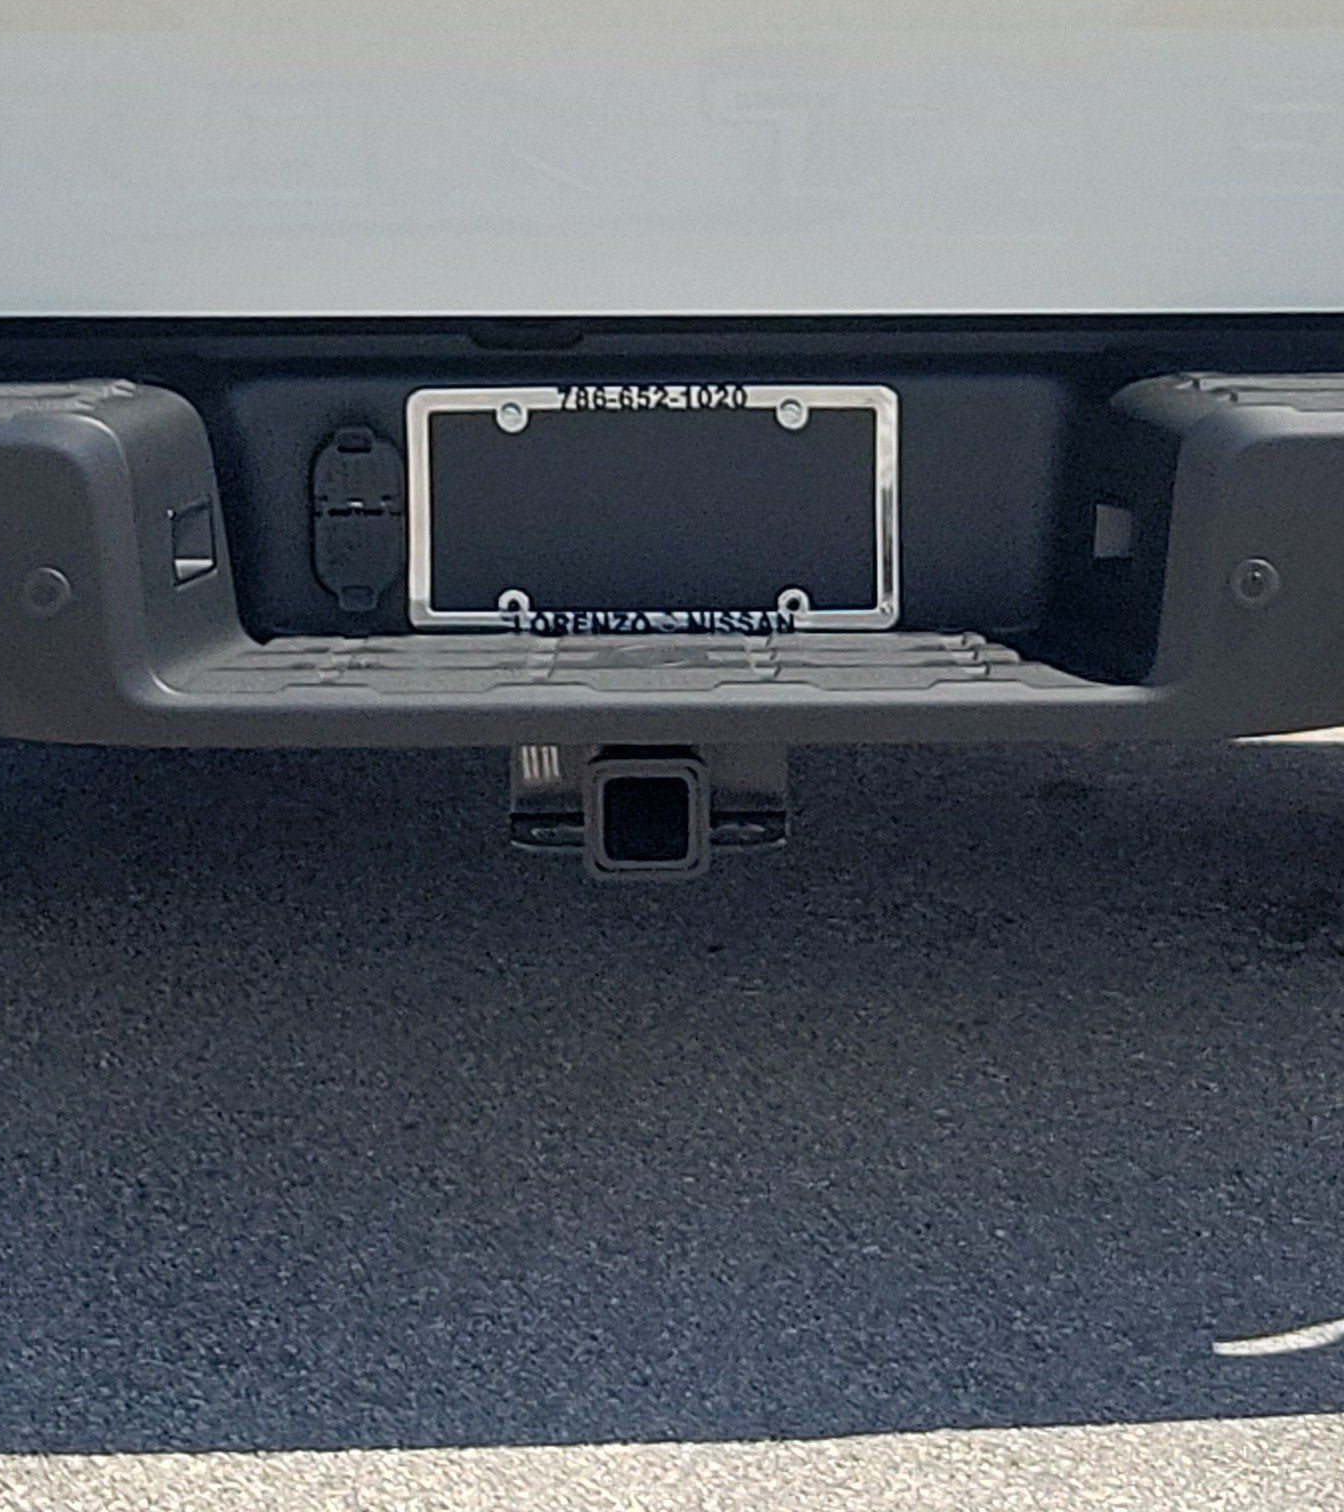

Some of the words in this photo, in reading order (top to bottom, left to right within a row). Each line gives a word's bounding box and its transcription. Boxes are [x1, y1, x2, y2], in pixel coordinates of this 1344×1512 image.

[557, 384, 749, 411] 786-652-1020
[511, 610, 653, 635] LORENZO
[688, 610, 795, 635] NISSAN
